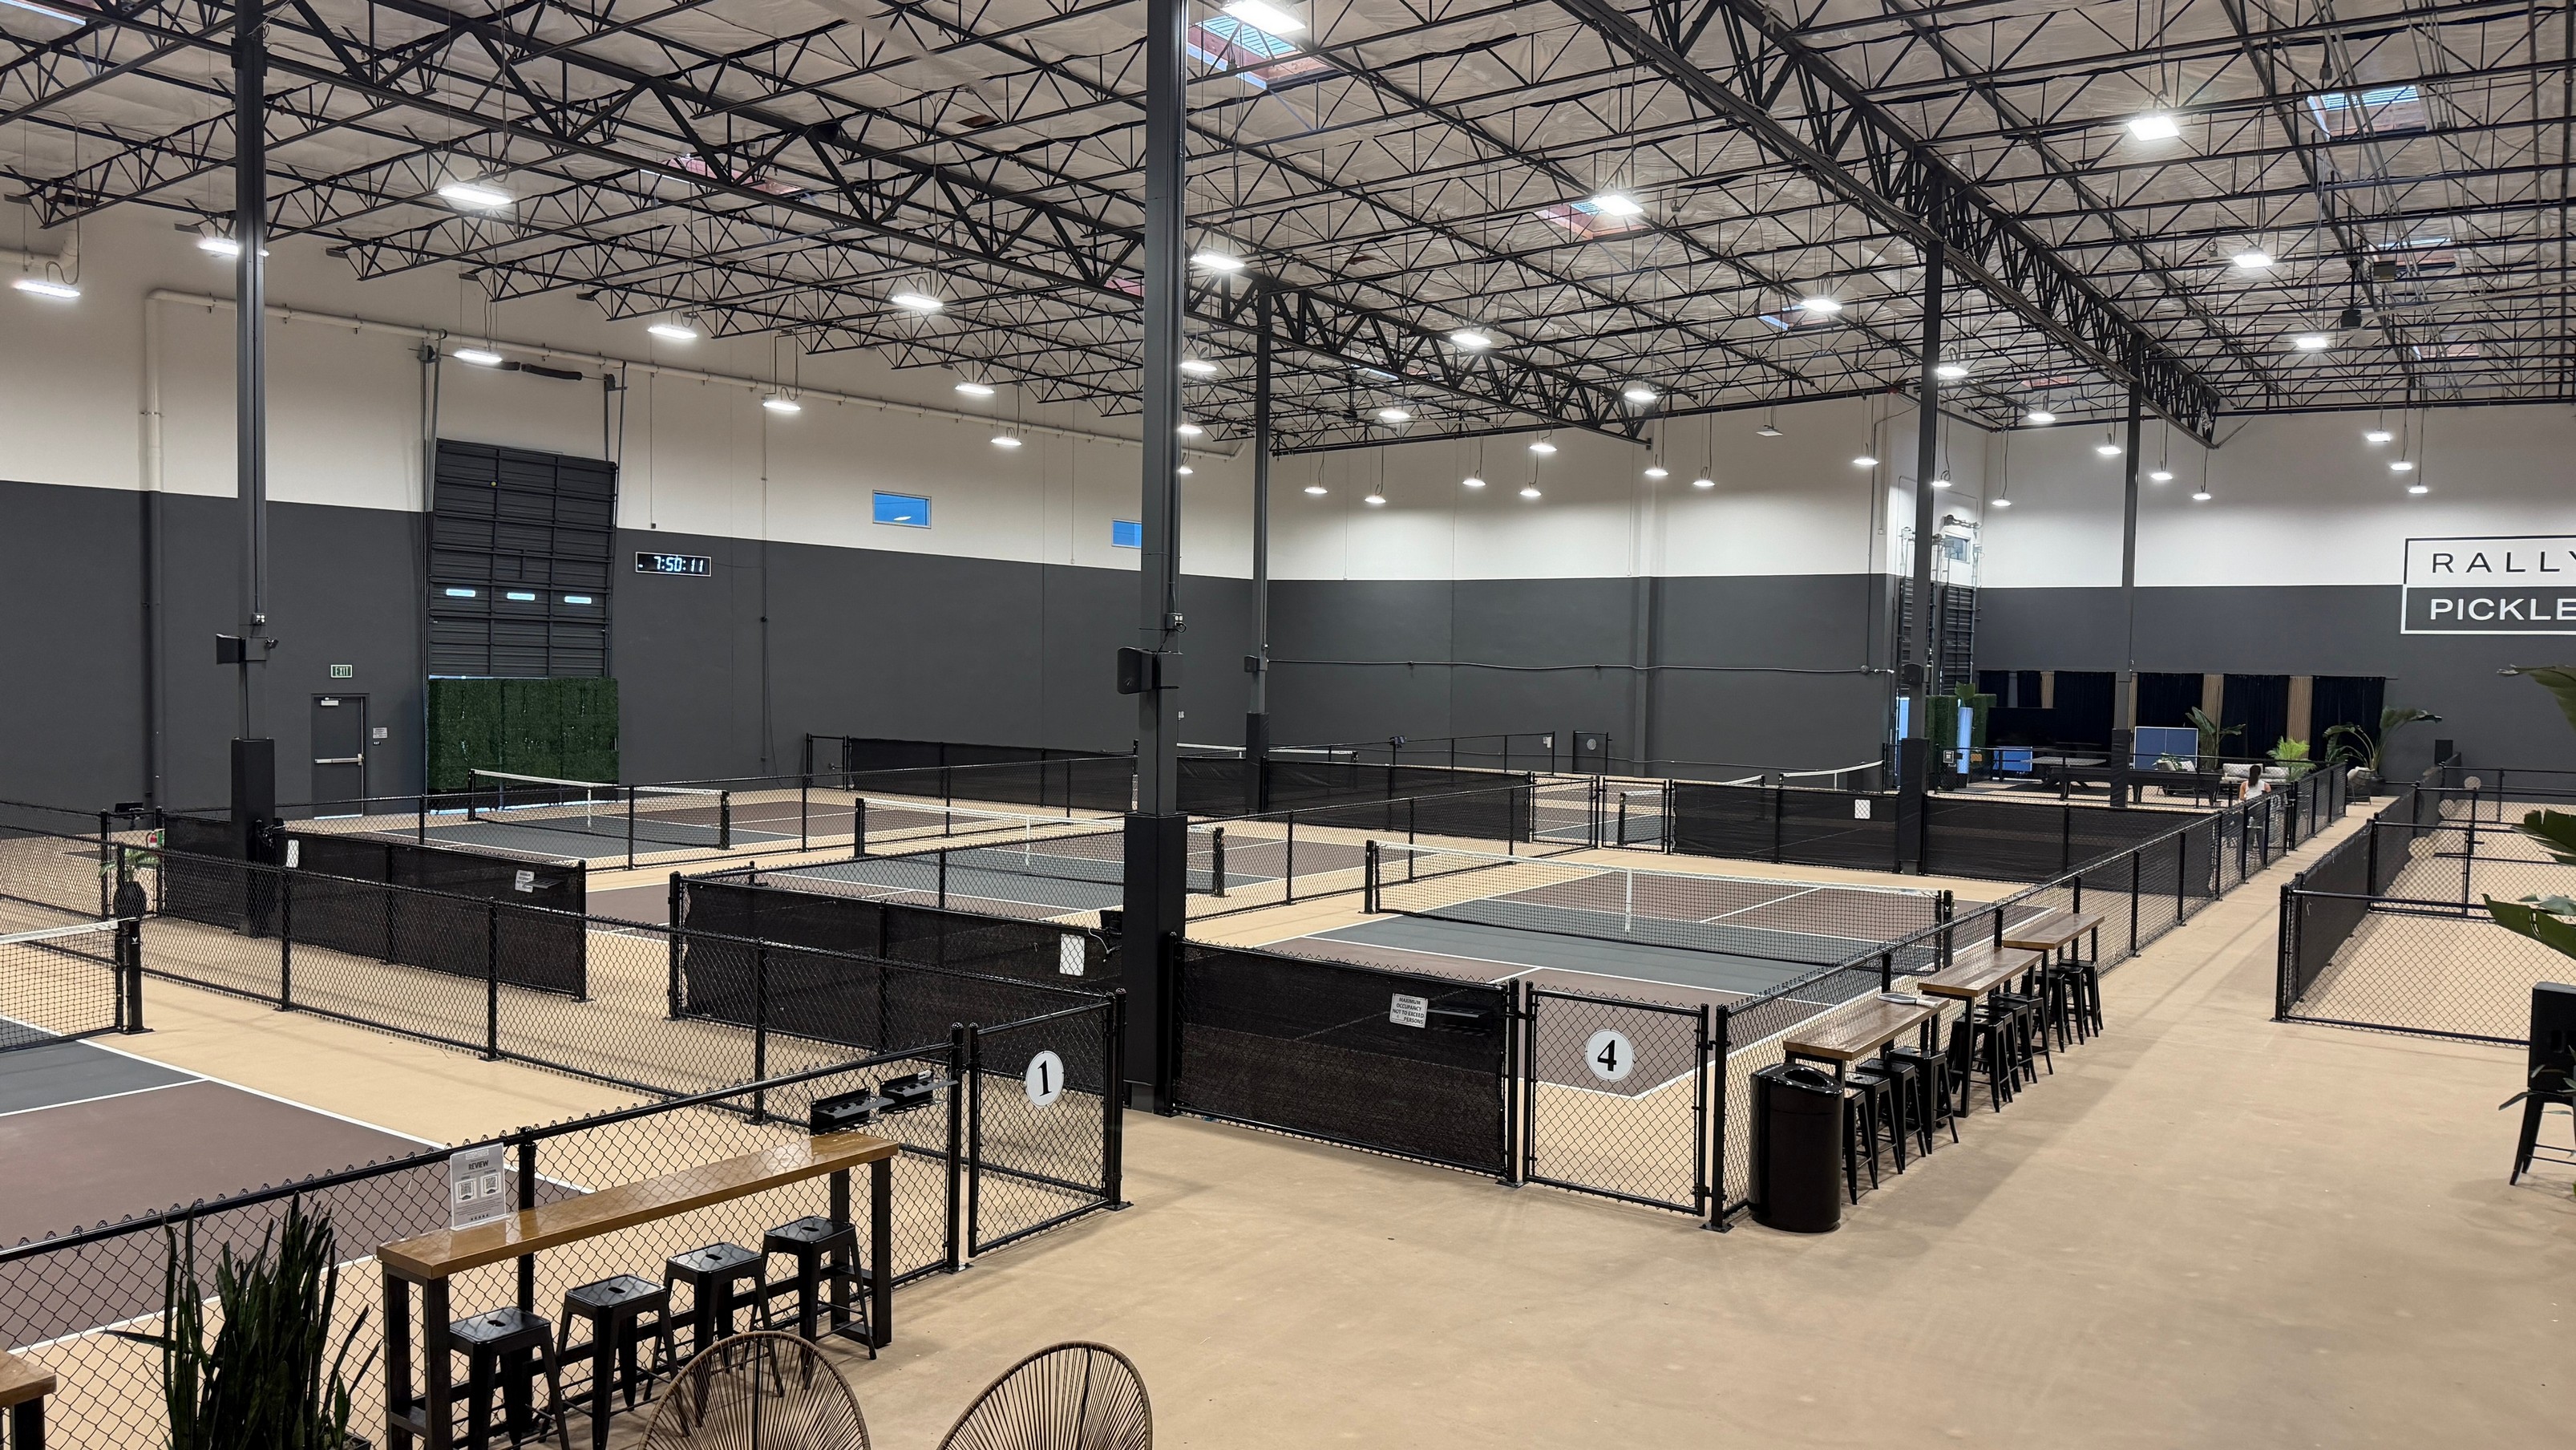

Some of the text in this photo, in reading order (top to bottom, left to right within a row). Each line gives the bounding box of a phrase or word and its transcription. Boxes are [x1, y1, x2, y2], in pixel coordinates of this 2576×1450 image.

[653, 556, 704, 573] 7:50:11
[2430, 598, 2576, 621] PICKLE
[335, 666, 349, 676] EXIT
[1398, 997, 1421, 1005] MAXIMUM
[1396, 1002, 1421, 1011] OCCUPANCY
[1404, 1016, 1423, 1024] PERSONS
[1597, 1039, 1617, 1071] 4
[1037, 1059, 1052, 1097] 1
[468, 1160, 488, 1170] REVIEW
